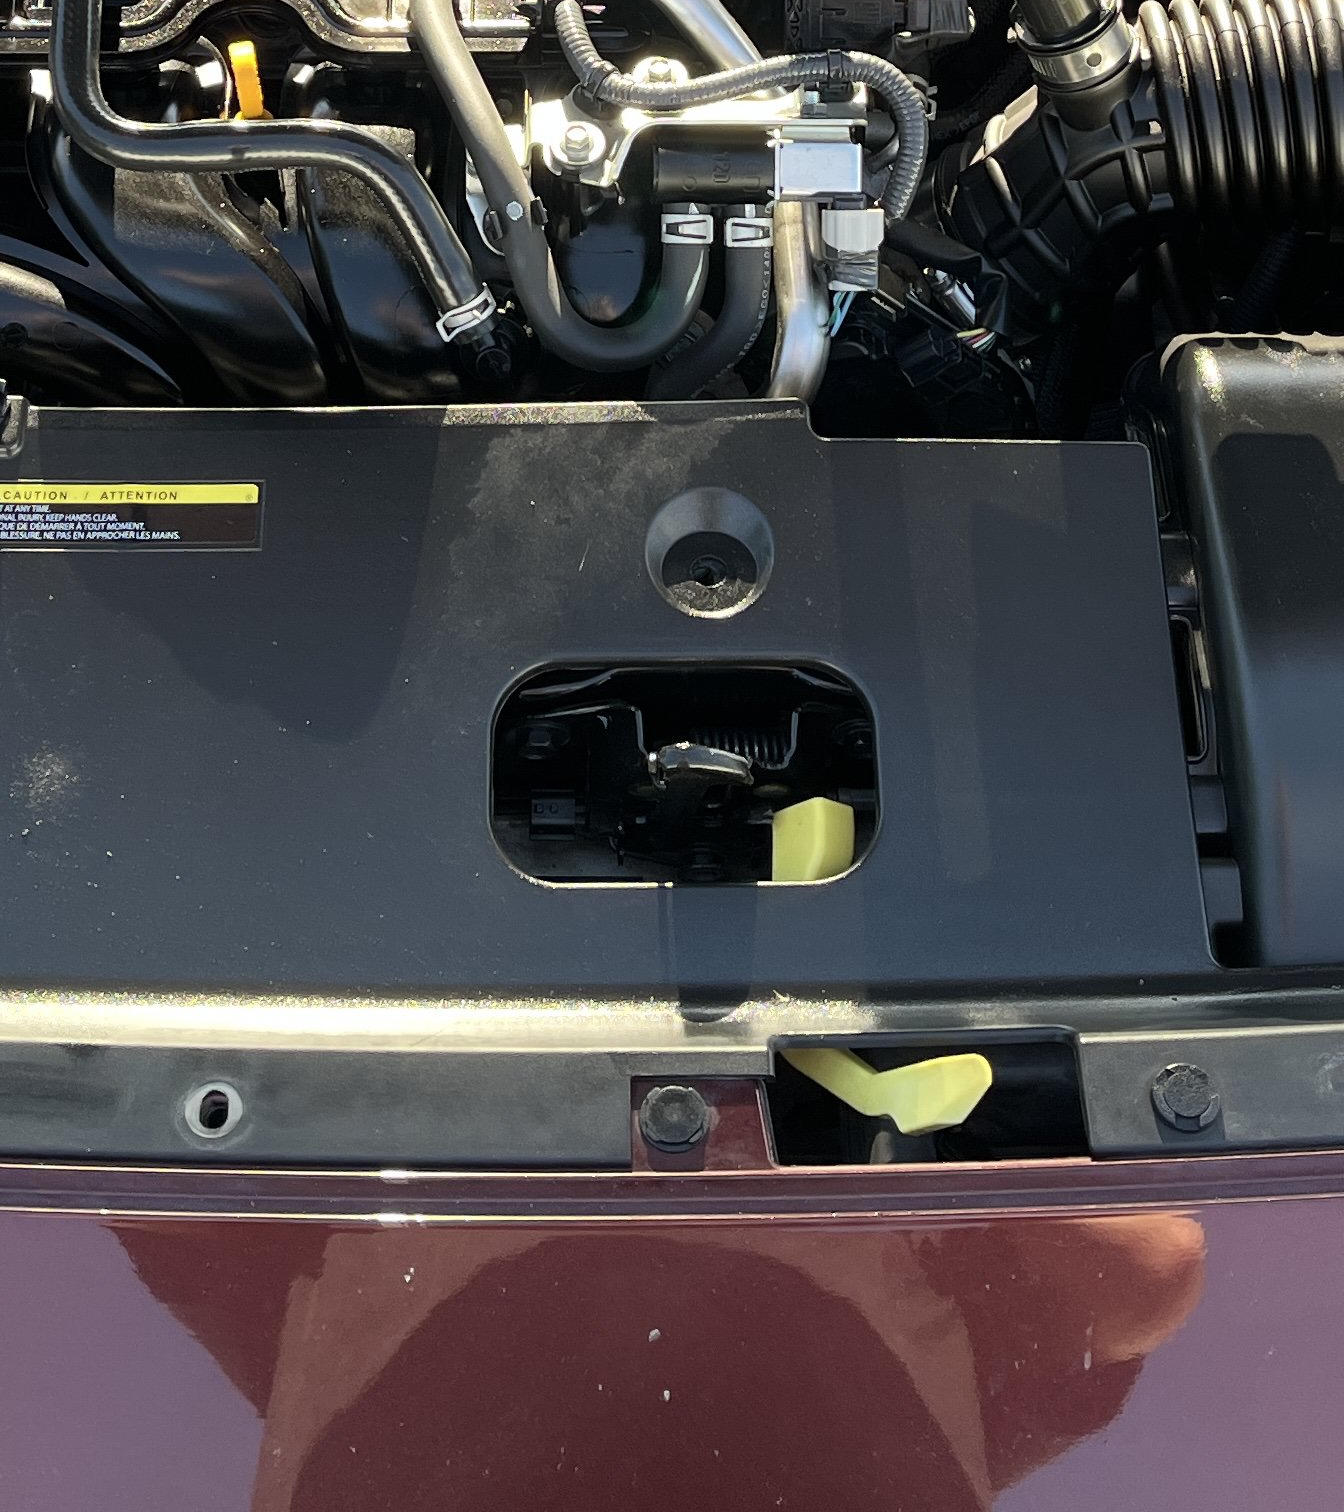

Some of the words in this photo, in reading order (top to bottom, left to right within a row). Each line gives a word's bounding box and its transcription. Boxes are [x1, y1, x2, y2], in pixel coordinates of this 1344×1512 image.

[3, 490, 68, 500] CAUTION
[100, 491, 178, 500] ATTENTION
[4, 504, 15, 512] AT
[15, 504, 32, 512] ANY
[46, 513, 64, 521] KEEP
[65, 513, 92, 521] HANDS
[17, 522, 28, 530] DE
[83, 522, 105, 530] TOUT
[43, 531, 55, 539] NE
[56, 531, 71, 539] PAS
[73, 531, 84, 539] EN
[86, 531, 136, 539] APPROCHER
[137, 531, 150, 539] LES
